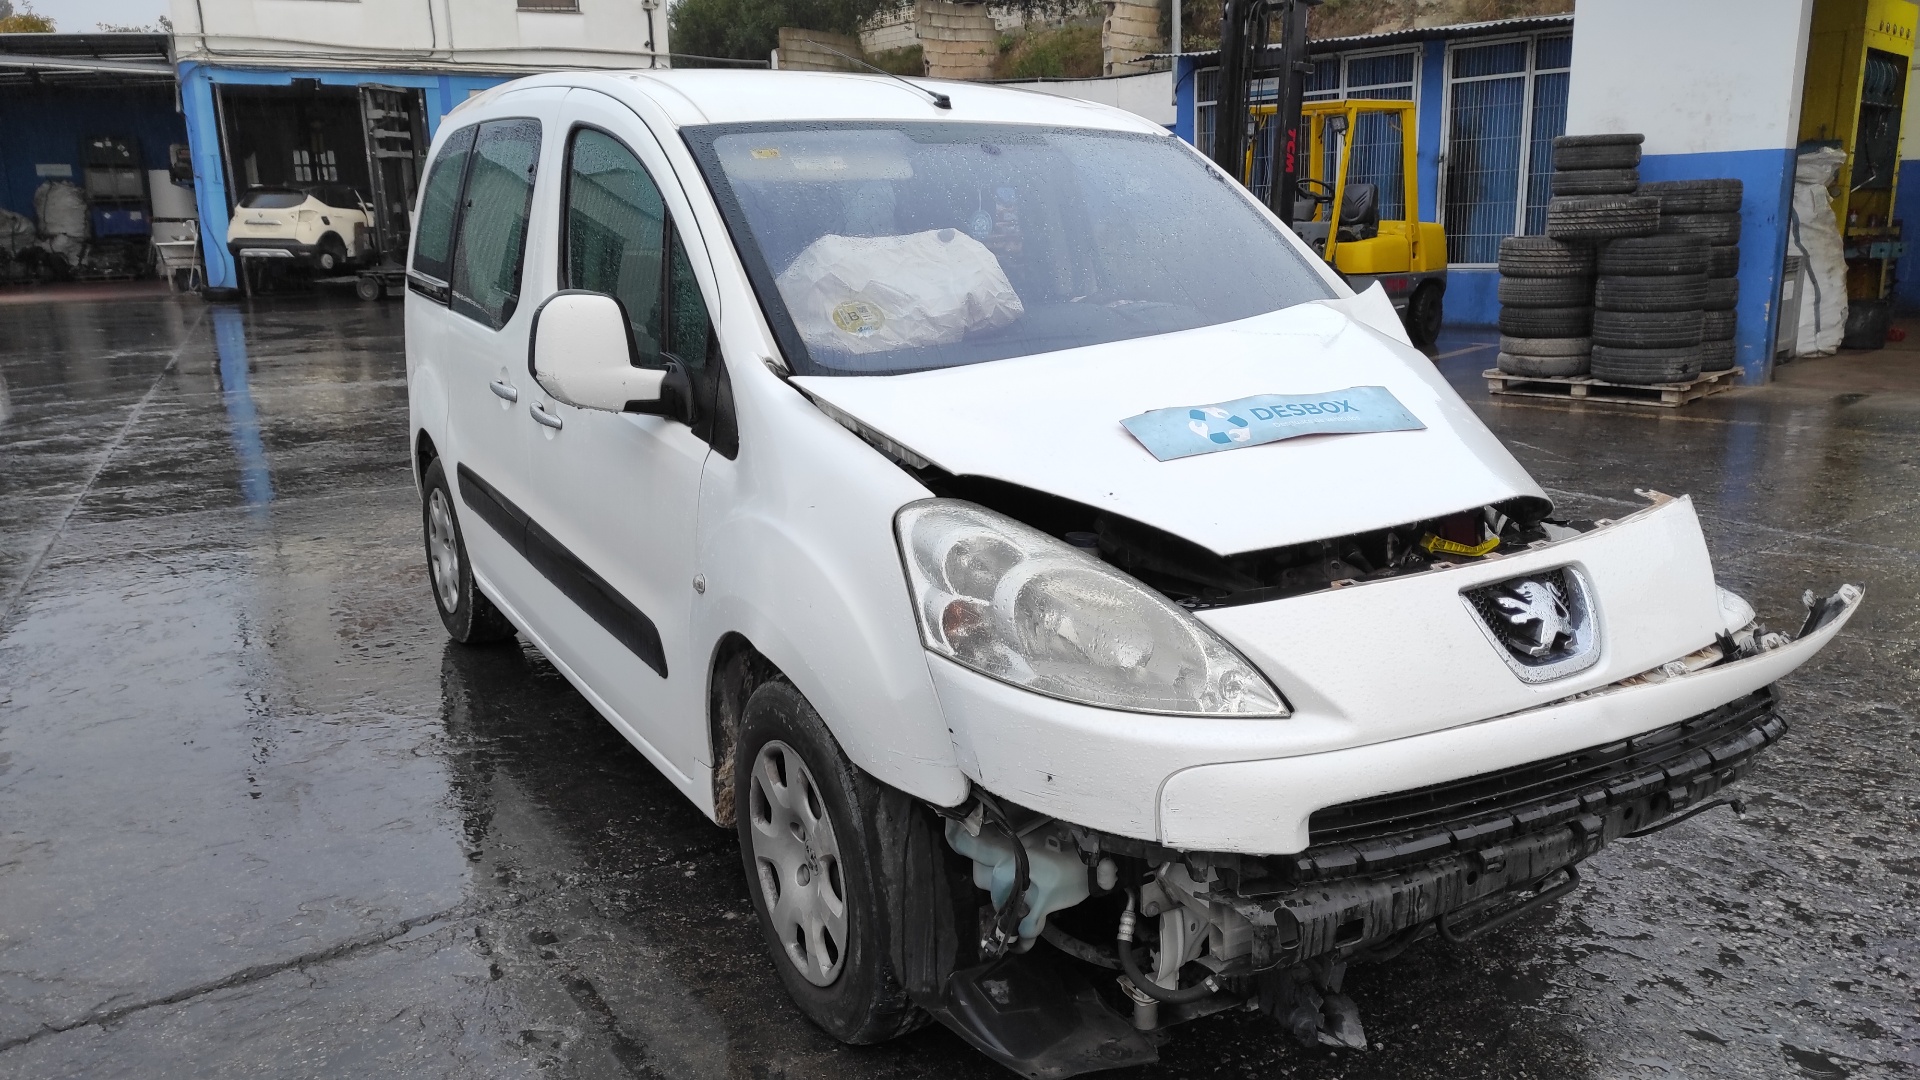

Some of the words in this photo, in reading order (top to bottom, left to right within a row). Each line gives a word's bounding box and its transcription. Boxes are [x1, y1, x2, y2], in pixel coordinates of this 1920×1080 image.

[1285, 128, 1297, 173] TCM
[847, 311, 860, 321] B
[1249, 399, 1360, 420] DESBOX
[1313, 416, 1325, 424] de
